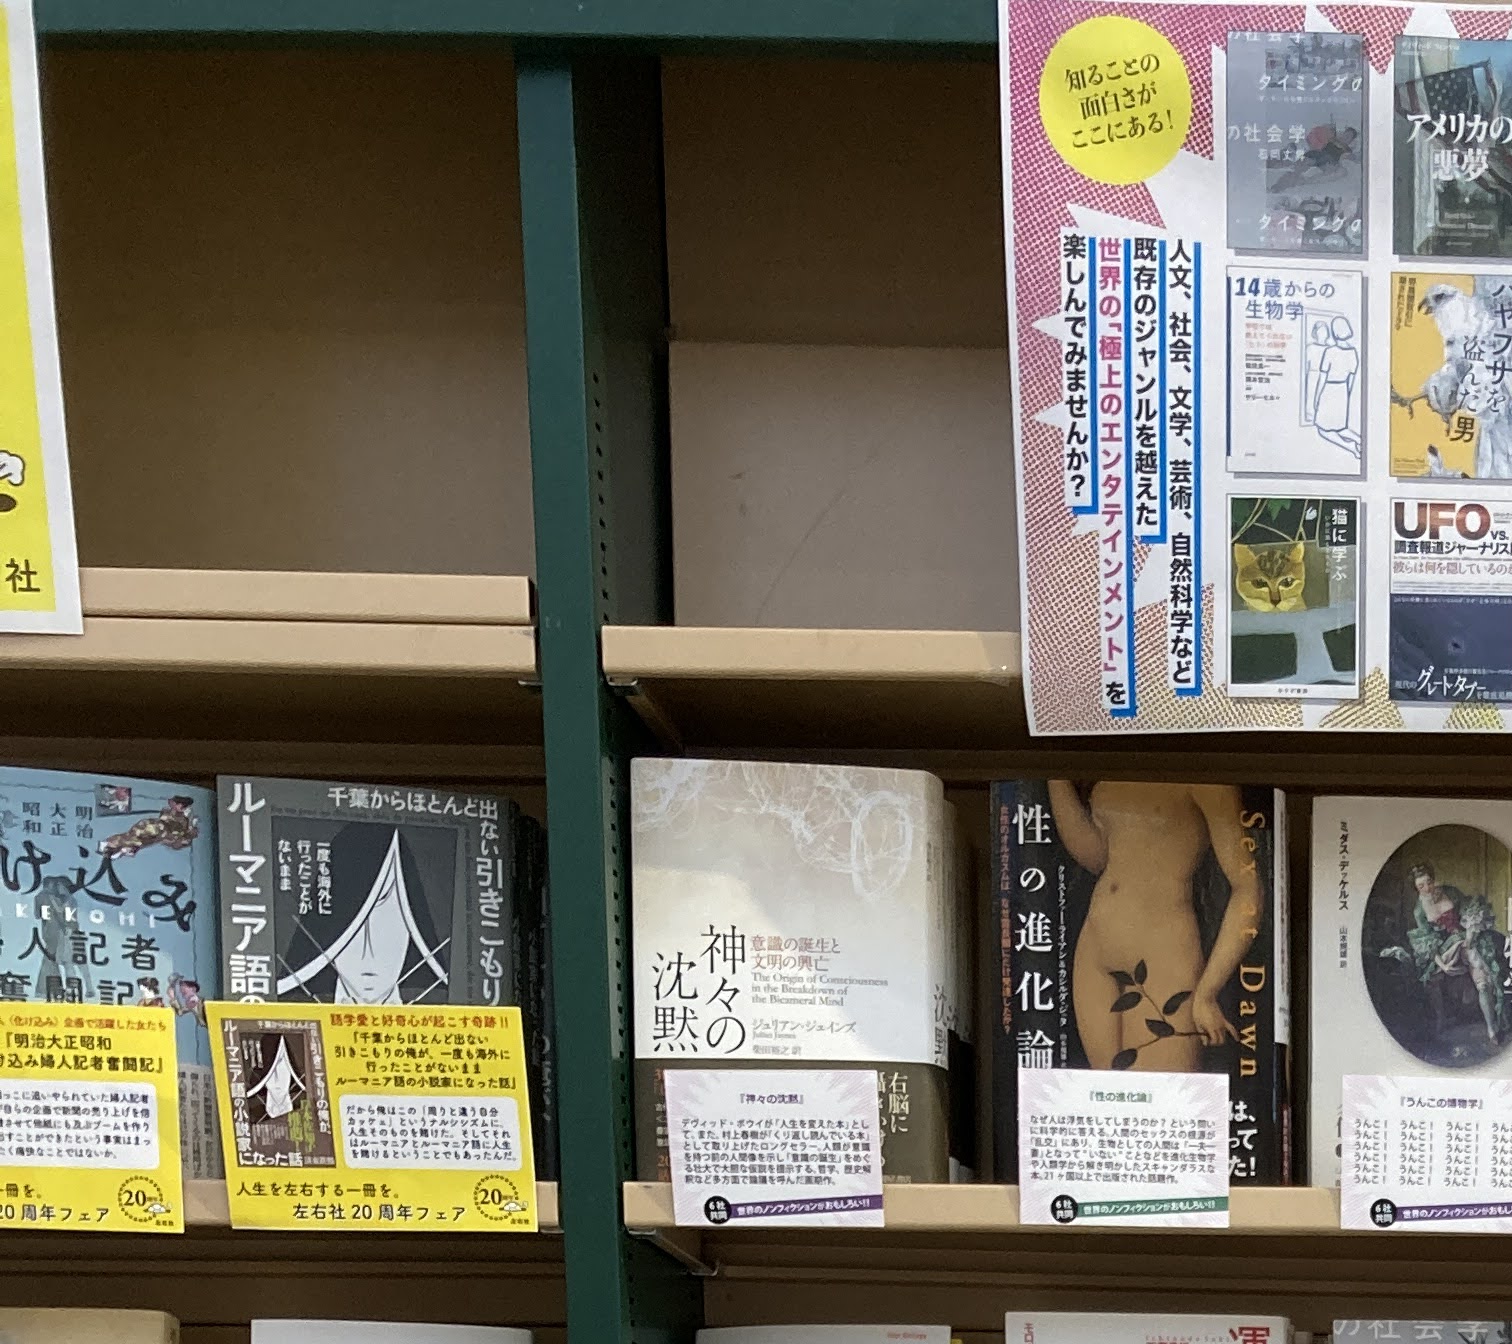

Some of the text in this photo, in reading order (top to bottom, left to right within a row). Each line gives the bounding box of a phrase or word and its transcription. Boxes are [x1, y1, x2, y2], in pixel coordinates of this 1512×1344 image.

[1235, 277, 1336, 298] 14歳からの
[1245, 299, 1304, 321] 生物学
[1133, 241, 1159, 525] 既存のジャンルを越えた
[1394, 501, 1490, 541] UFO
[750, 936, 841, 954] 意識の誕生と
[1013, 804, 1056, 1070] 性の進化論
[751, 953, 829, 972] 文明の興亡
[366, 1062, 482, 1075] 行ったことがないまま
[1399, 1097, 1484, 1110] 『うんこの博物学』
[236, 1182, 399, 1198] 人生を左右する一冊を。
